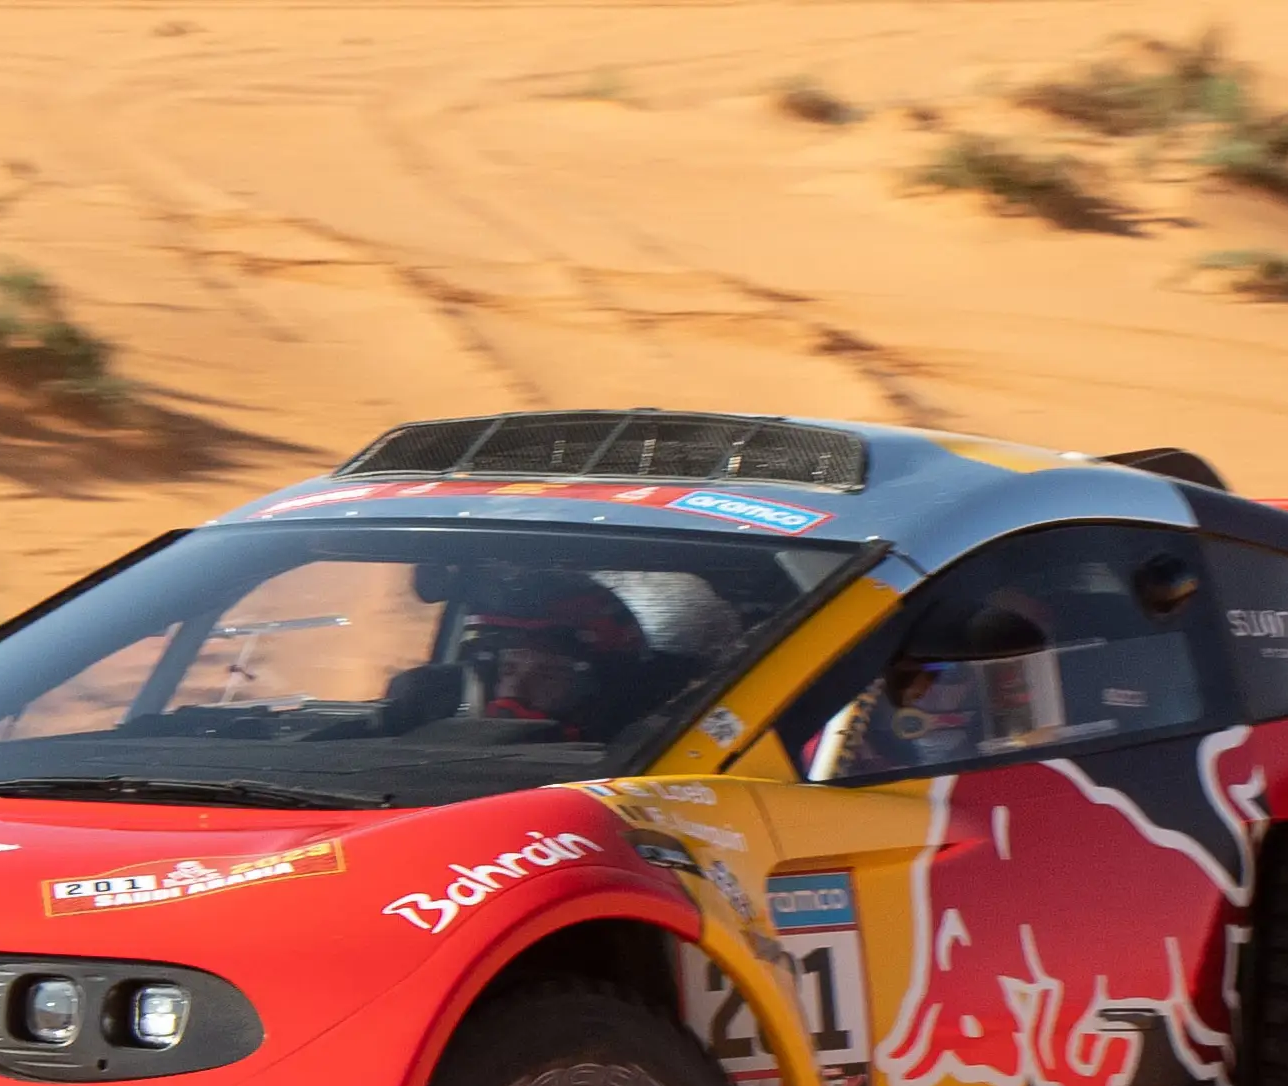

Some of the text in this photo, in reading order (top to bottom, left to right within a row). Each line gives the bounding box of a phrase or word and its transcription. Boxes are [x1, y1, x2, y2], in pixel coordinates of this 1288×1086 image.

[686, 492, 809, 527] aramco
[65, 878, 143, 897] 201
[94, 862, 295, 907] SAUDI ARABIA
[381, 831, 605, 934] Bahrain
[706, 945, 852, 1059] 21
